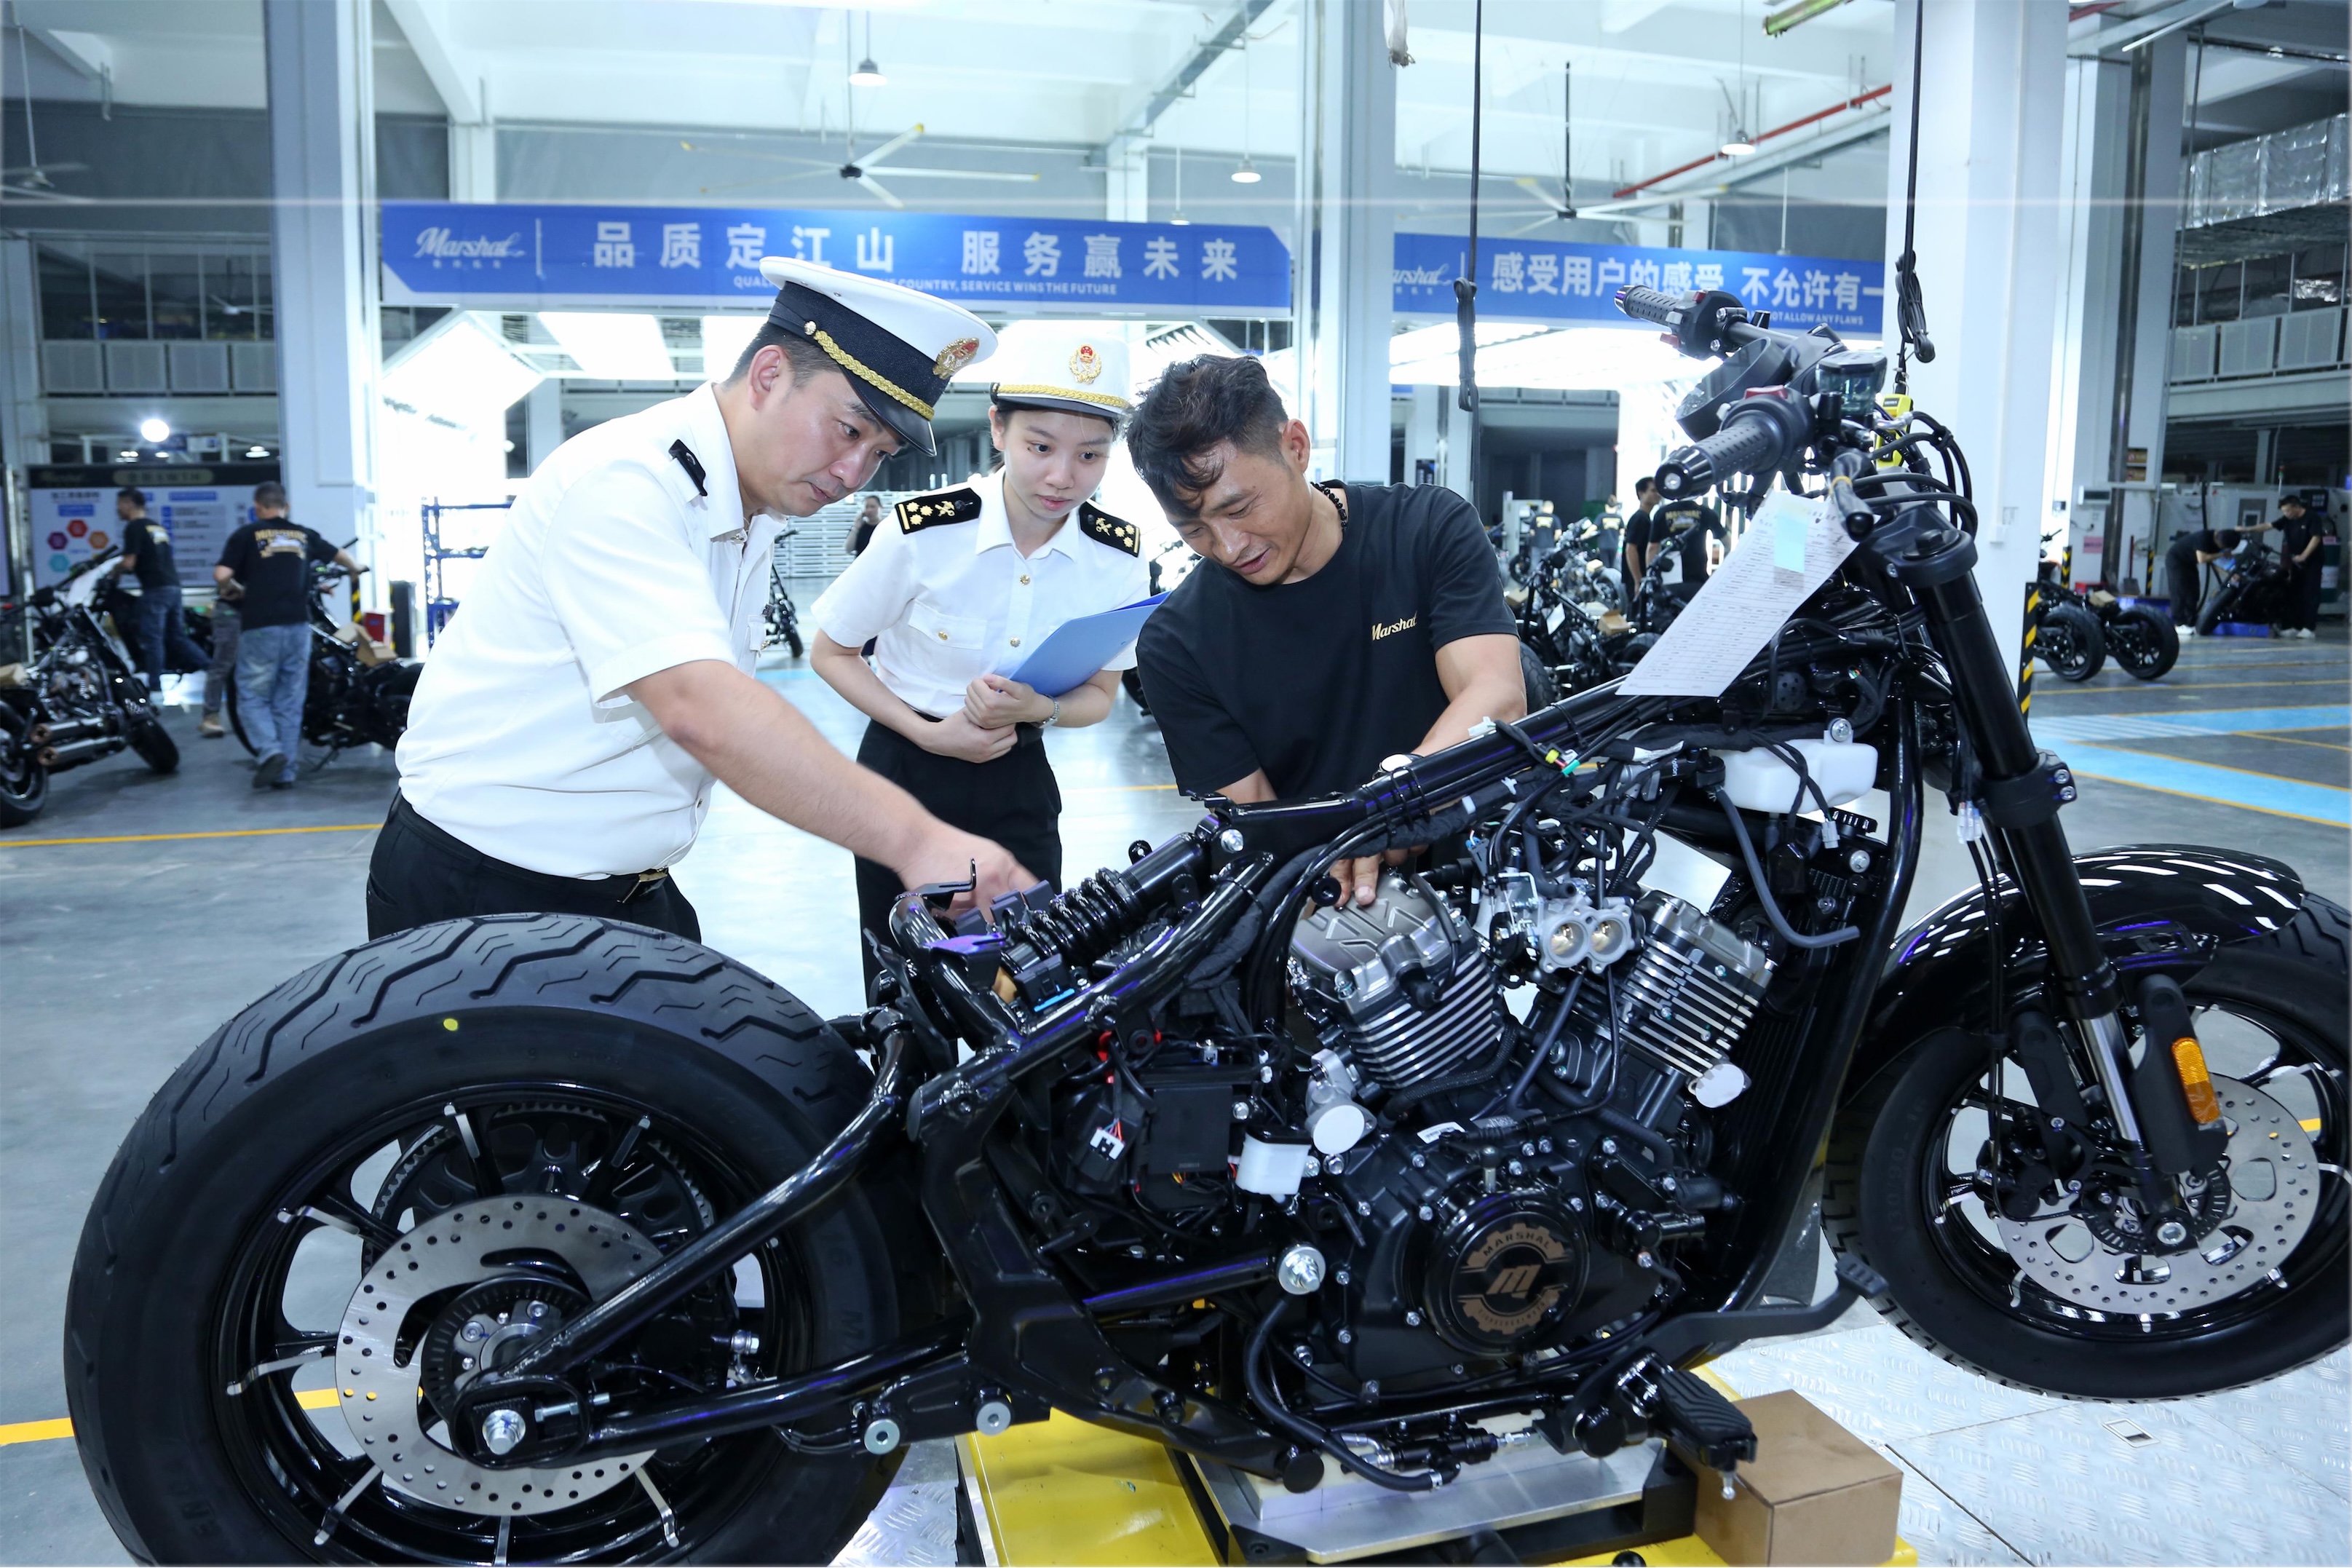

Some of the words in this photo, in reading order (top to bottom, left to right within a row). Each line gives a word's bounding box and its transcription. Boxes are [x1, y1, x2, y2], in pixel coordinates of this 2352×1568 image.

[413, 226, 527, 258] Marshal
[593, 221, 894, 274] 品质定江山
[961, 229, 1239, 282] 服务赢未来
[1393, 263, 1452, 286] arshal
[1492, 252, 1725, 297] 感受用户的感受
[1741, 267, 1883, 311] 不允许有一
[961, 280, 1011, 293] SERVICE
[1012, 281, 1043, 293] WINS
[1043, 282, 1068, 294] THE
[1070, 282, 1117, 296] FUTURE
[1770, 311, 1784, 321] OT
[1786, 312, 1814, 322] ALLOW
[1815, 313, 1834, 324] ANY
[1834, 314, 1864, 325] FLAWS
[1482, 1231, 1550, 1257] MARSHAL
